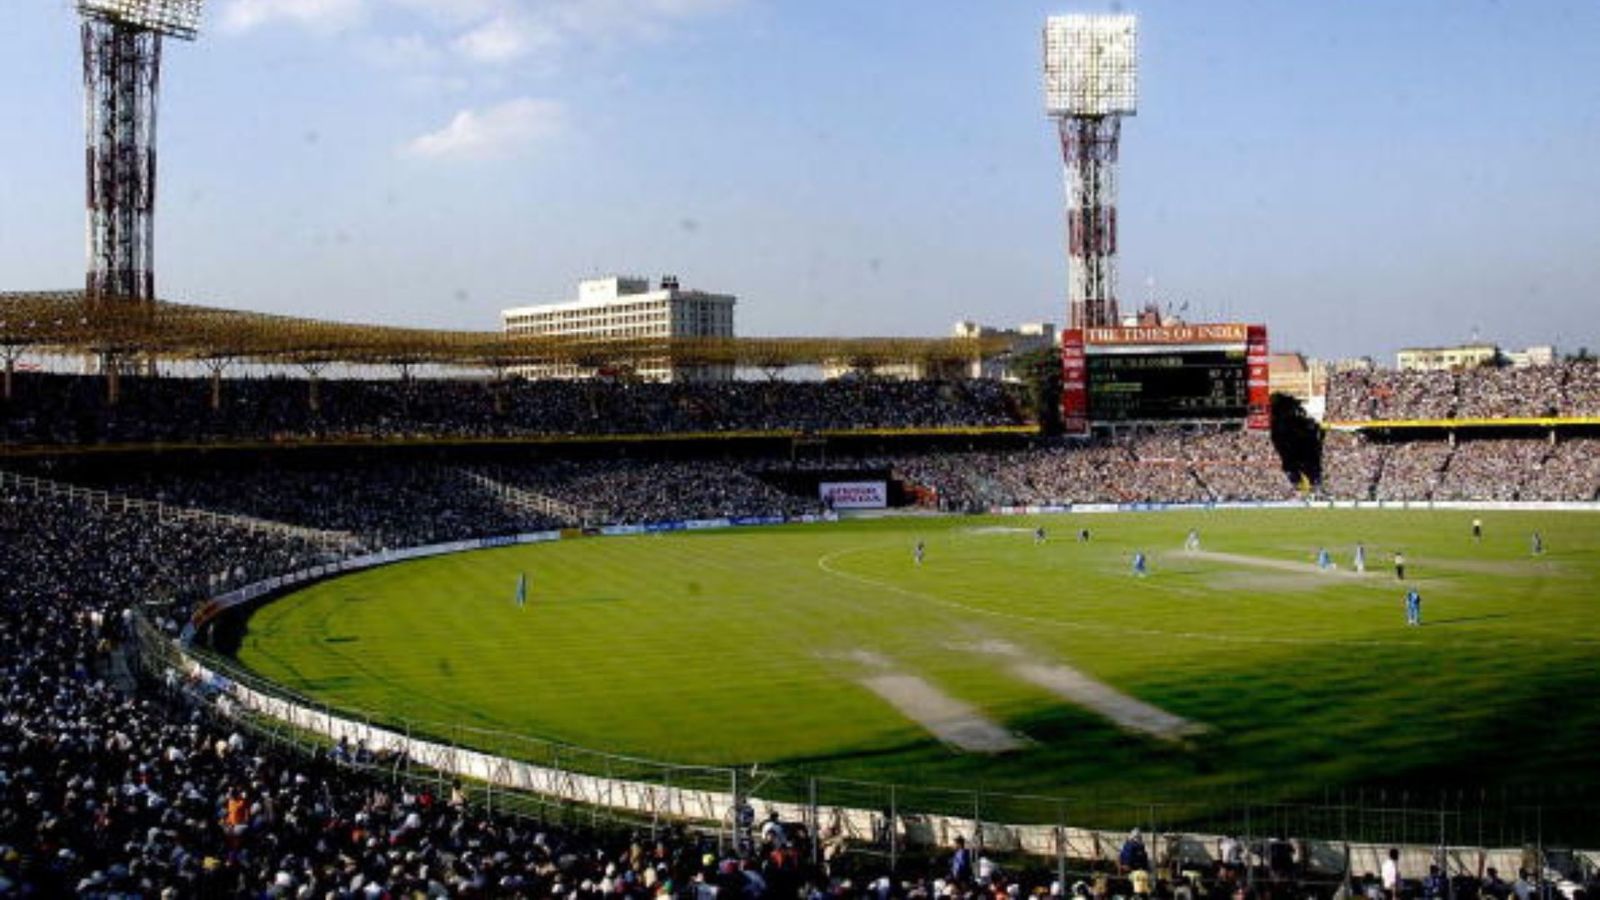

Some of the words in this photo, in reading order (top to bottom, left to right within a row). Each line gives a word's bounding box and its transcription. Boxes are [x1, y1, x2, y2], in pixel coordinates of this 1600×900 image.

[1090, 328, 1122, 341] THE
[1124, 328, 1169, 340] TIMES
[1174, 327, 1194, 340] OF
[1198, 325, 1243, 339] INDIA
